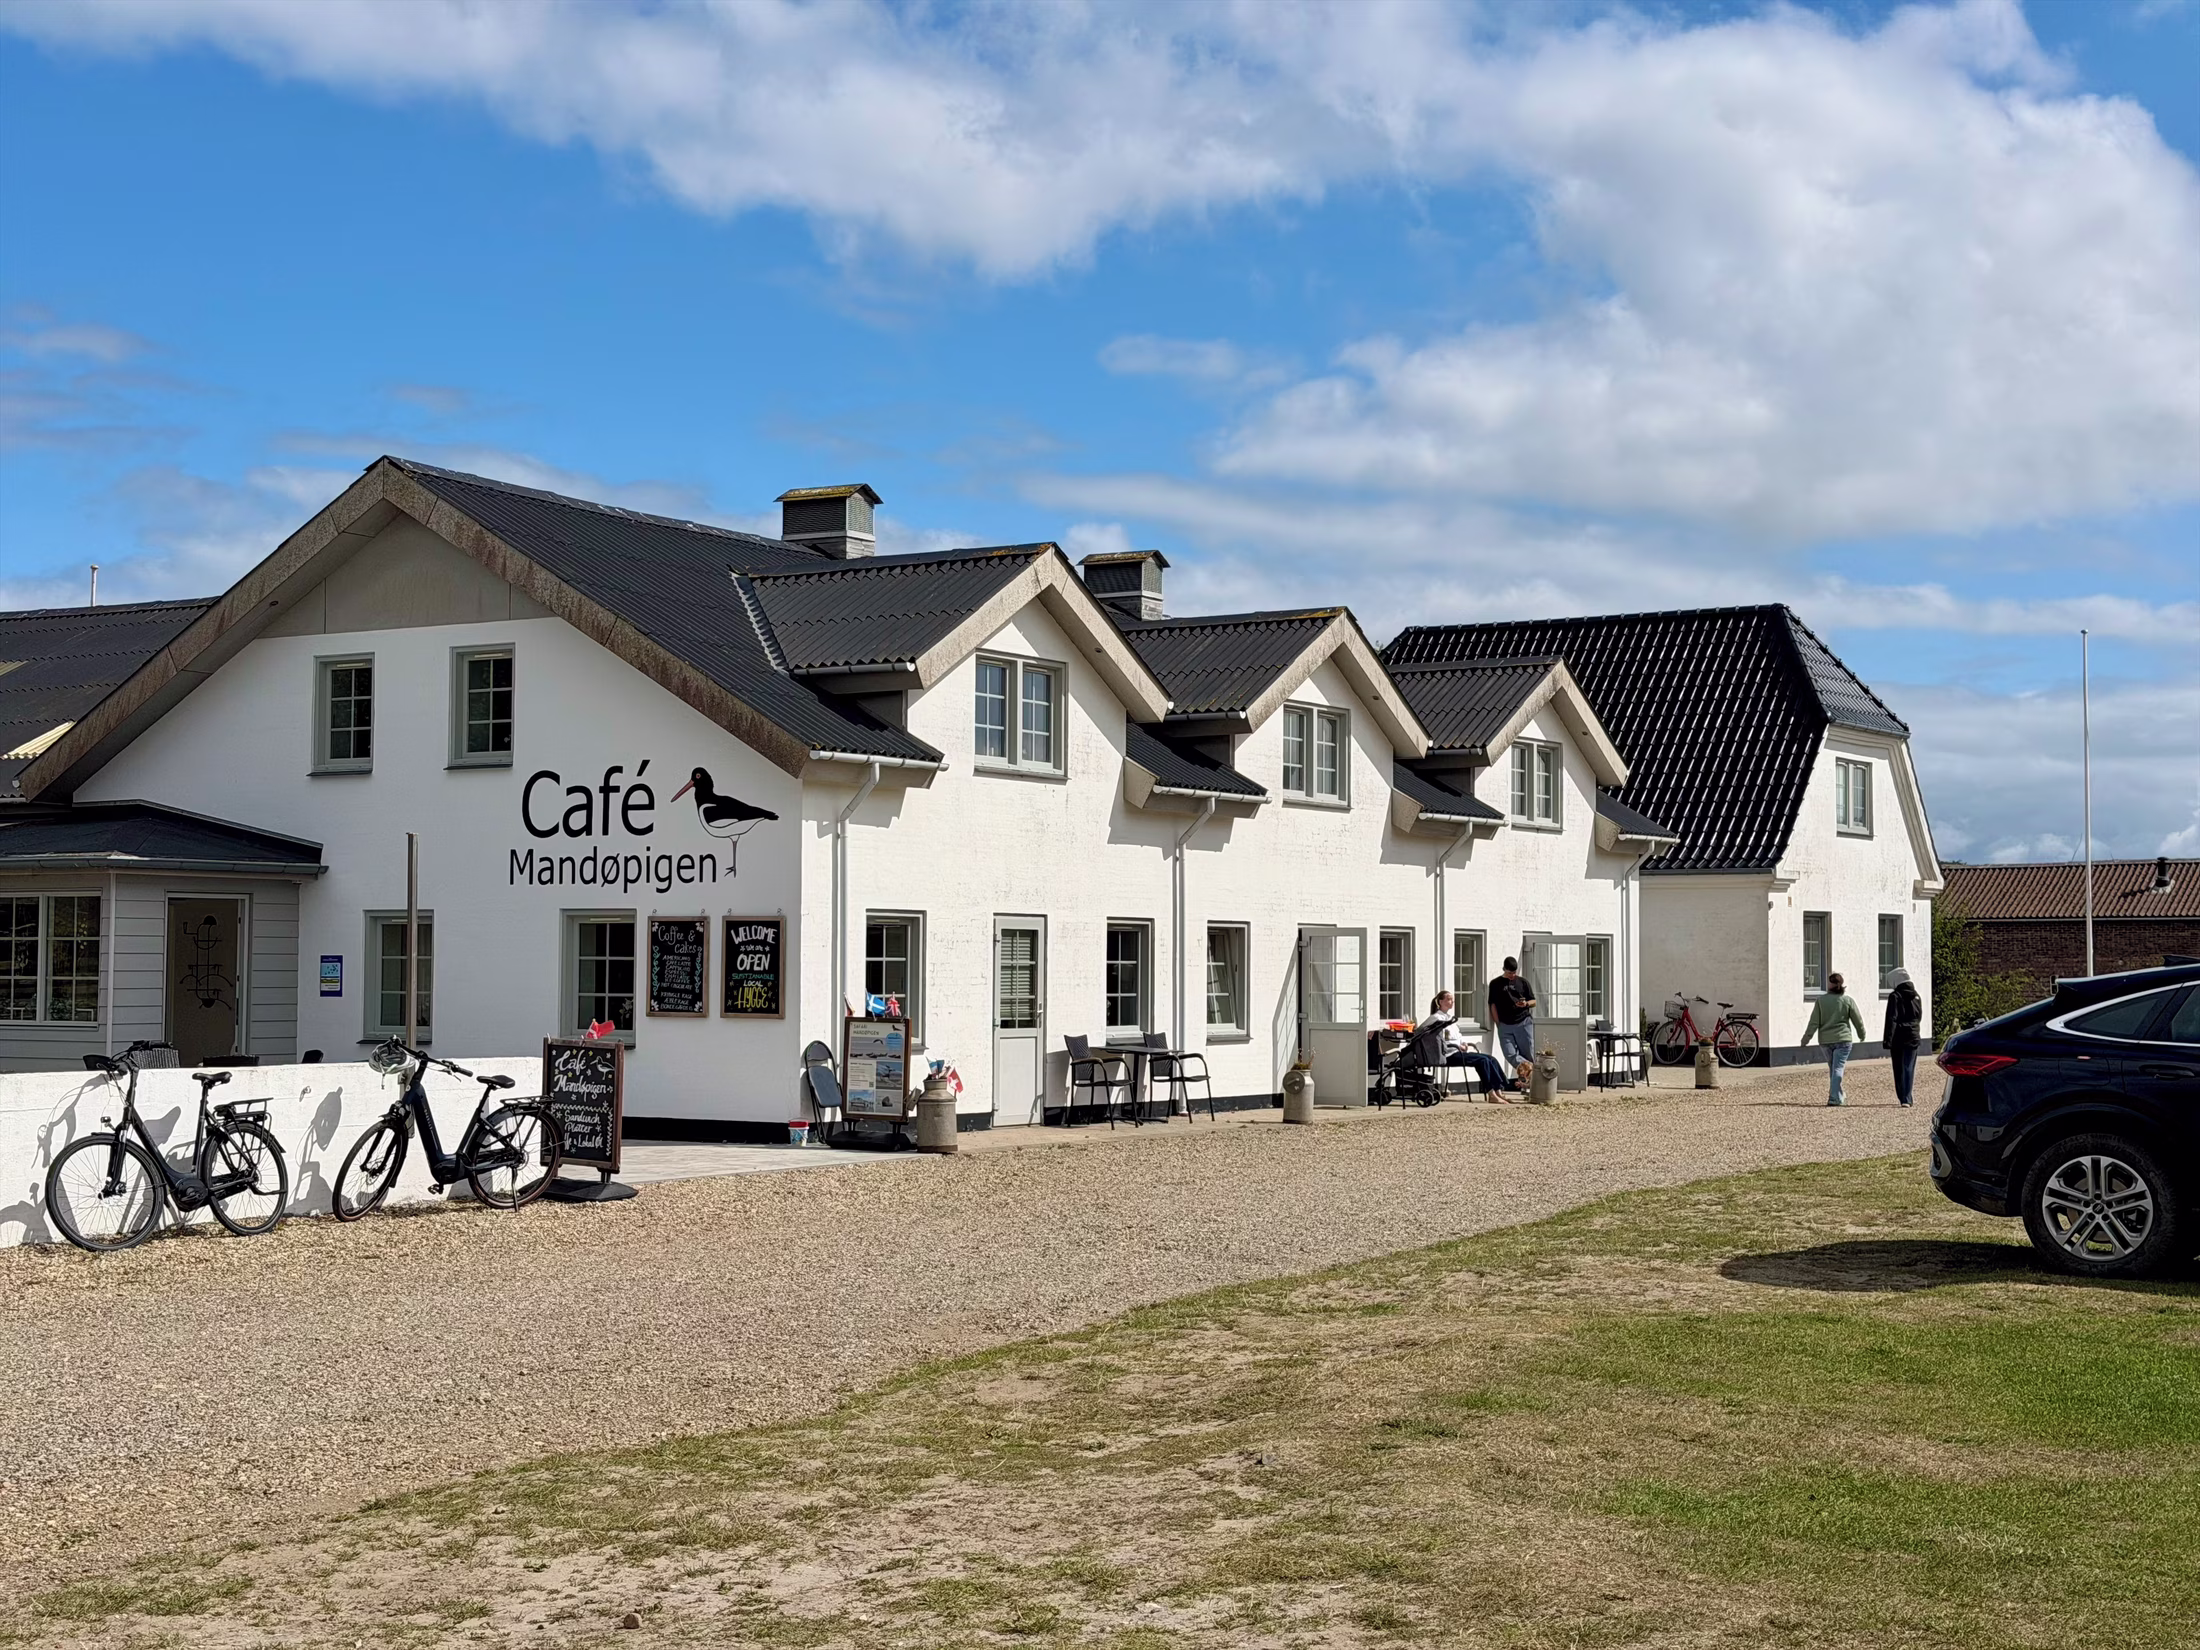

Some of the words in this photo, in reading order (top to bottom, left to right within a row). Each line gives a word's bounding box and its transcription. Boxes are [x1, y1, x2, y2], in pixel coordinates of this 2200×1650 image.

[522, 760, 655, 838] Café
[510, 846, 717, 893] Mandøpigen
[658, 925, 685, 946] Coffee
[688, 930, 696, 942] &
[730, 925, 777, 944] WELCOME
[736, 953, 770, 971] OPEN
[734, 986, 768, 1008] HYGGE
[555, 1049, 587, 1075] Café
[553, 1074, 607, 1102] Mandøpigen
